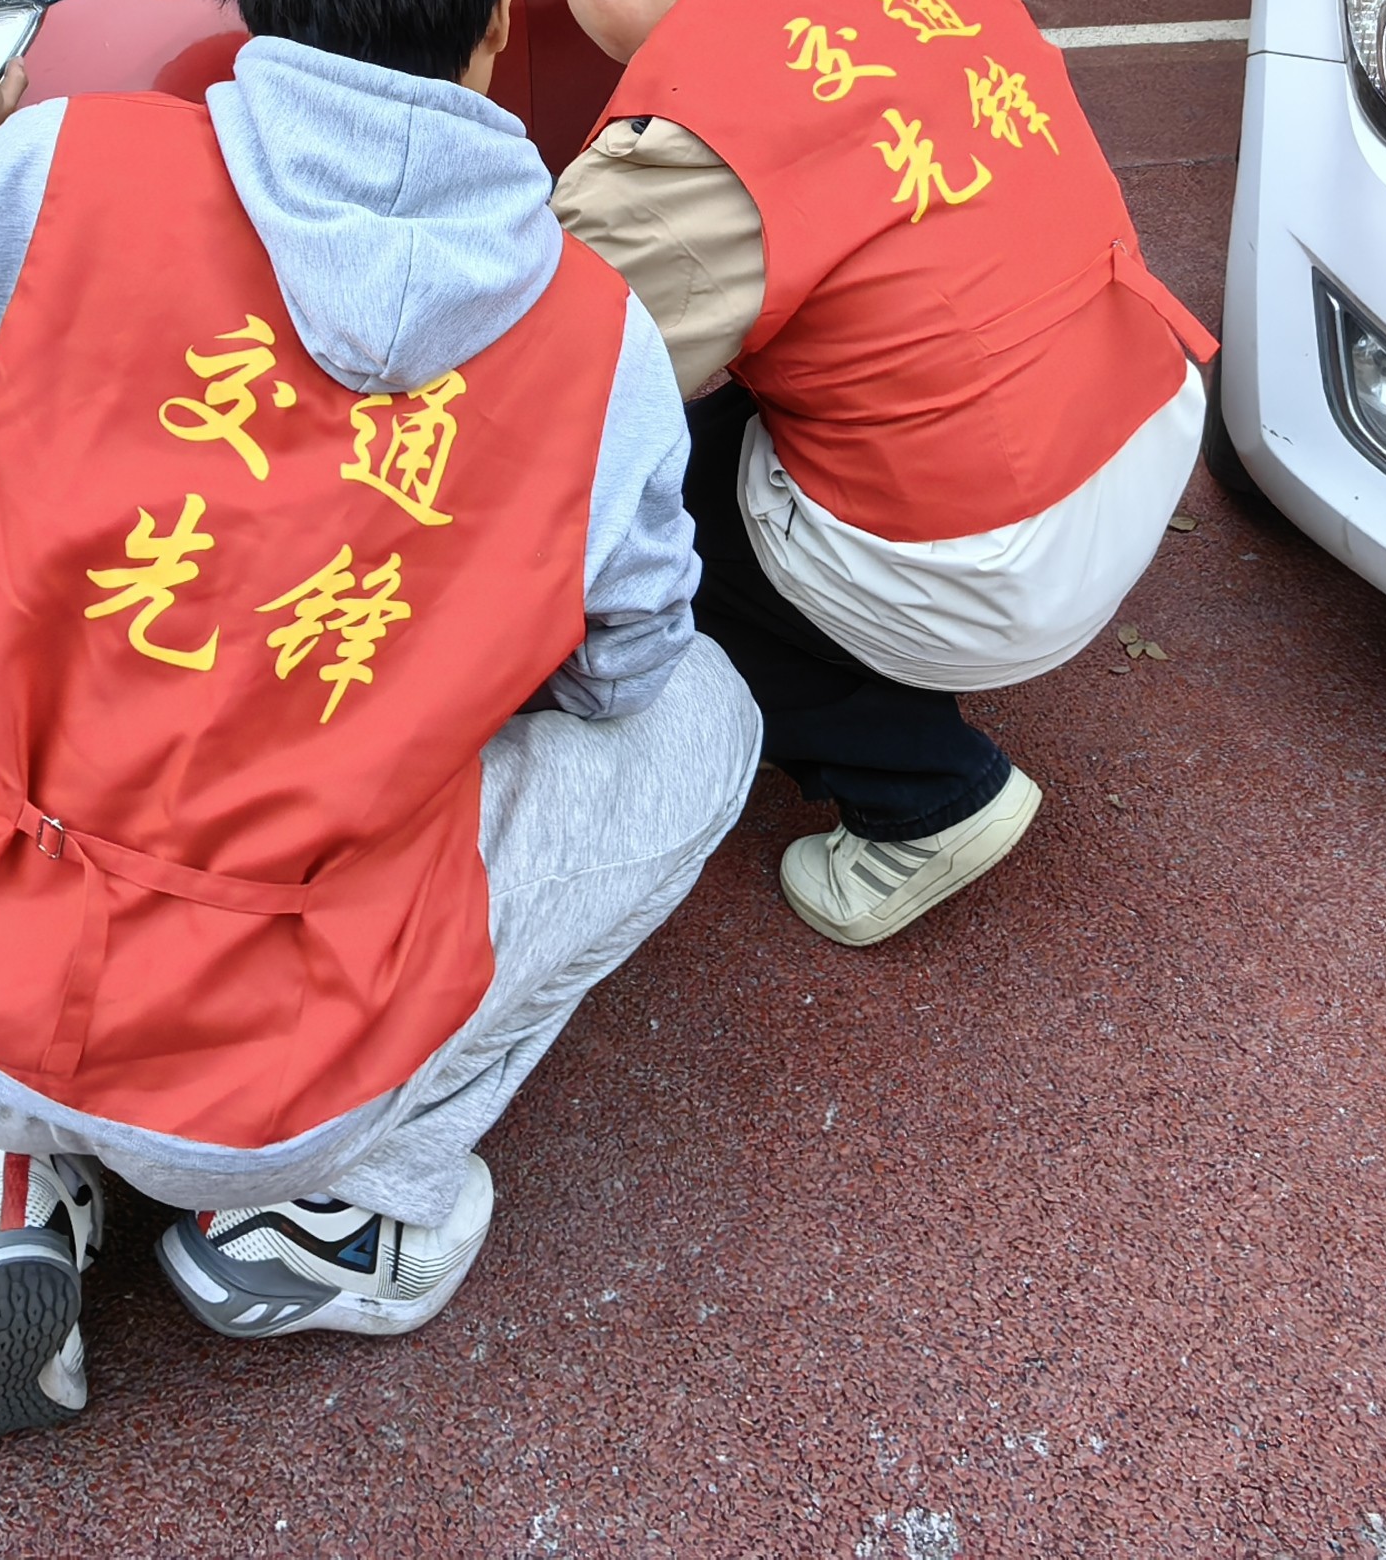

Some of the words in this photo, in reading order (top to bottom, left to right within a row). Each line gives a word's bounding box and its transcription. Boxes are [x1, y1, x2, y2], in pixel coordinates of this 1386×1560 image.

[870, 54, 1060, 224] 先锋
[157, 312, 468, 527] 交通
[83, 492, 412, 725] 先锋
